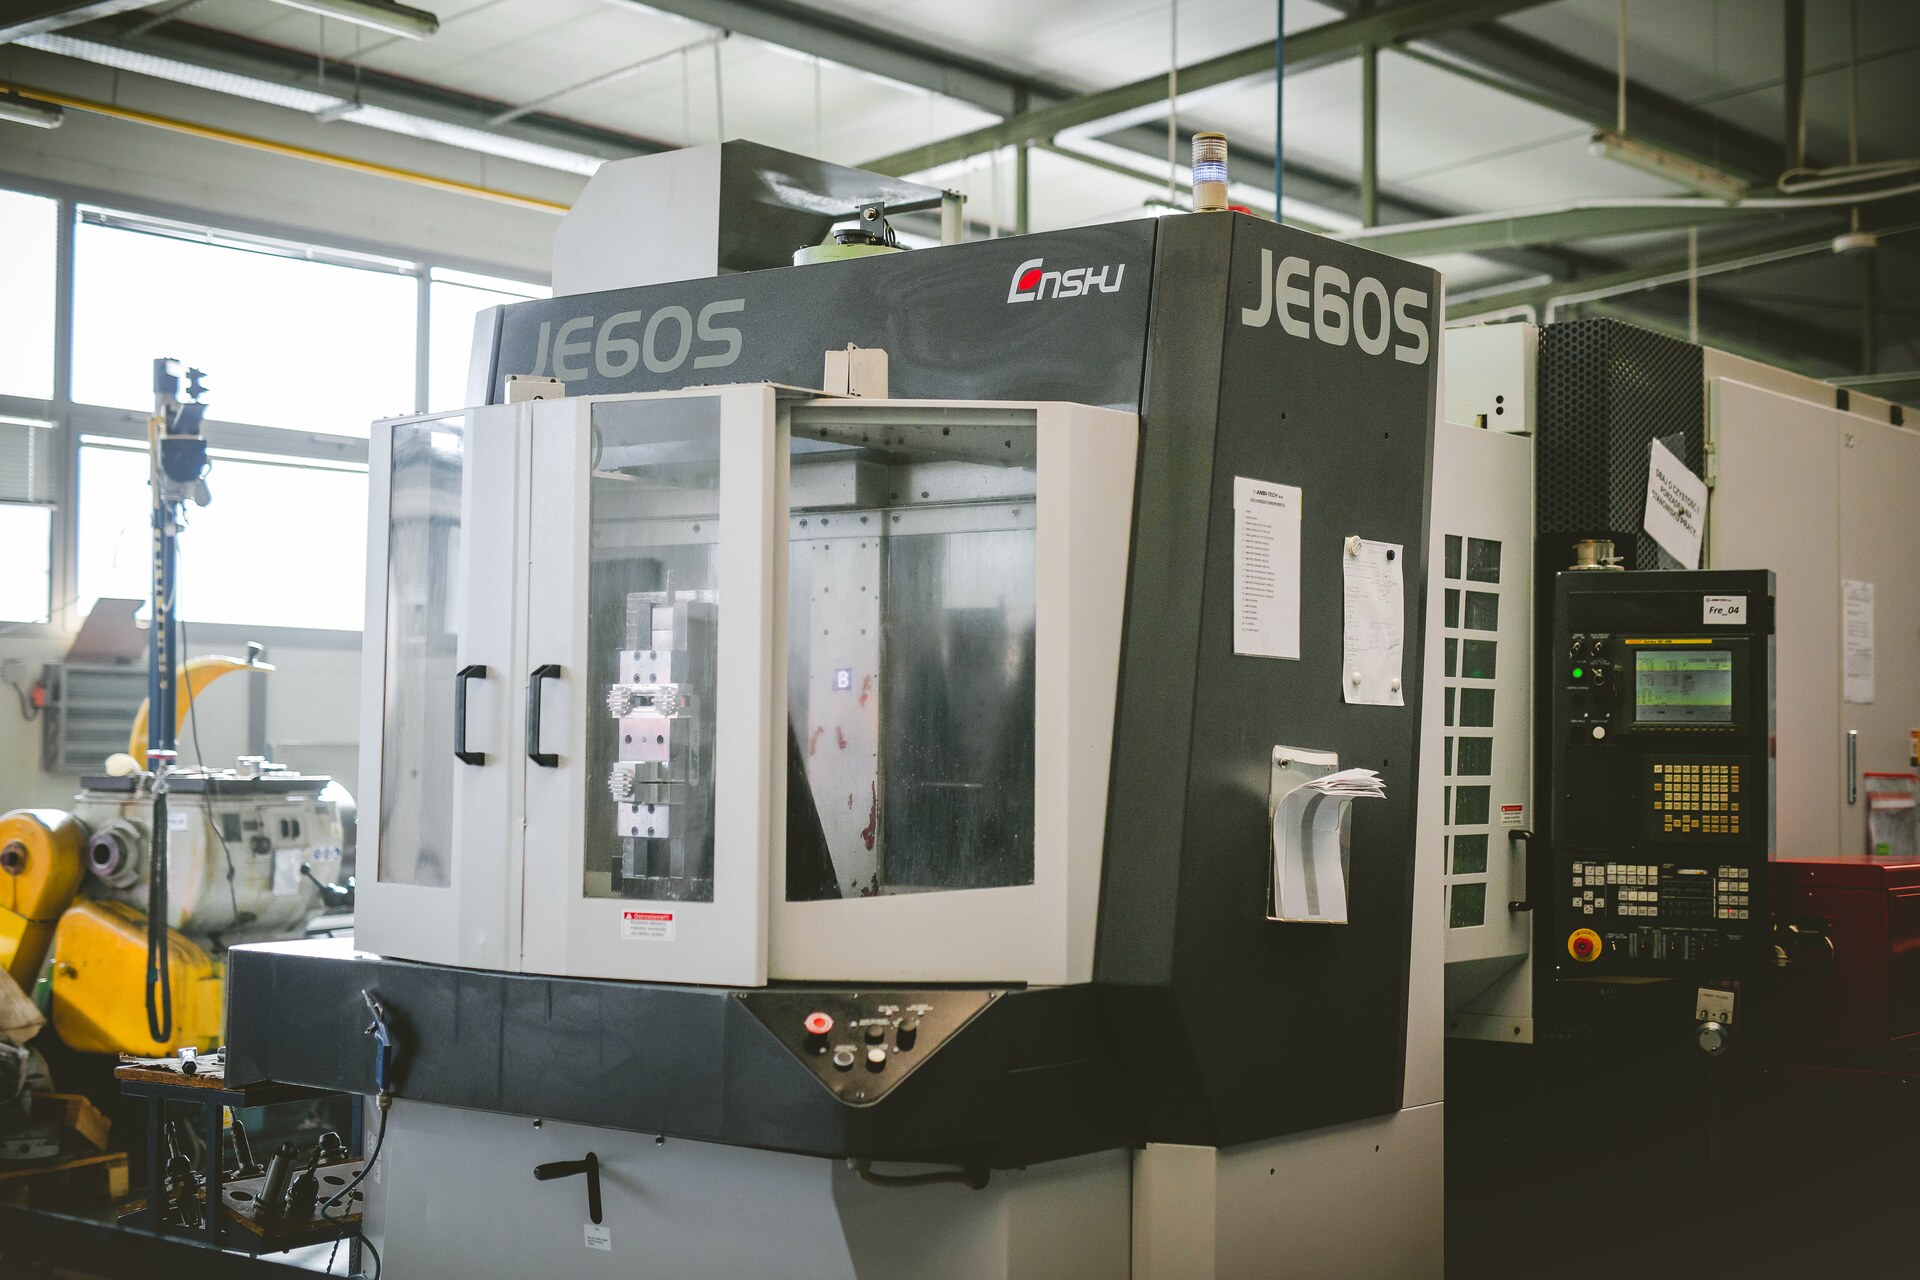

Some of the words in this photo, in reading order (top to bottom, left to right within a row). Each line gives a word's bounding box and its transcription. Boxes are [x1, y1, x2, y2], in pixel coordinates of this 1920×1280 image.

[1242, 248, 1429, 365] JE60S
[530, 299, 745, 381] JE60S
[1709, 606, 1740, 616] Fre_04
[838, 670, 849, 688] B
